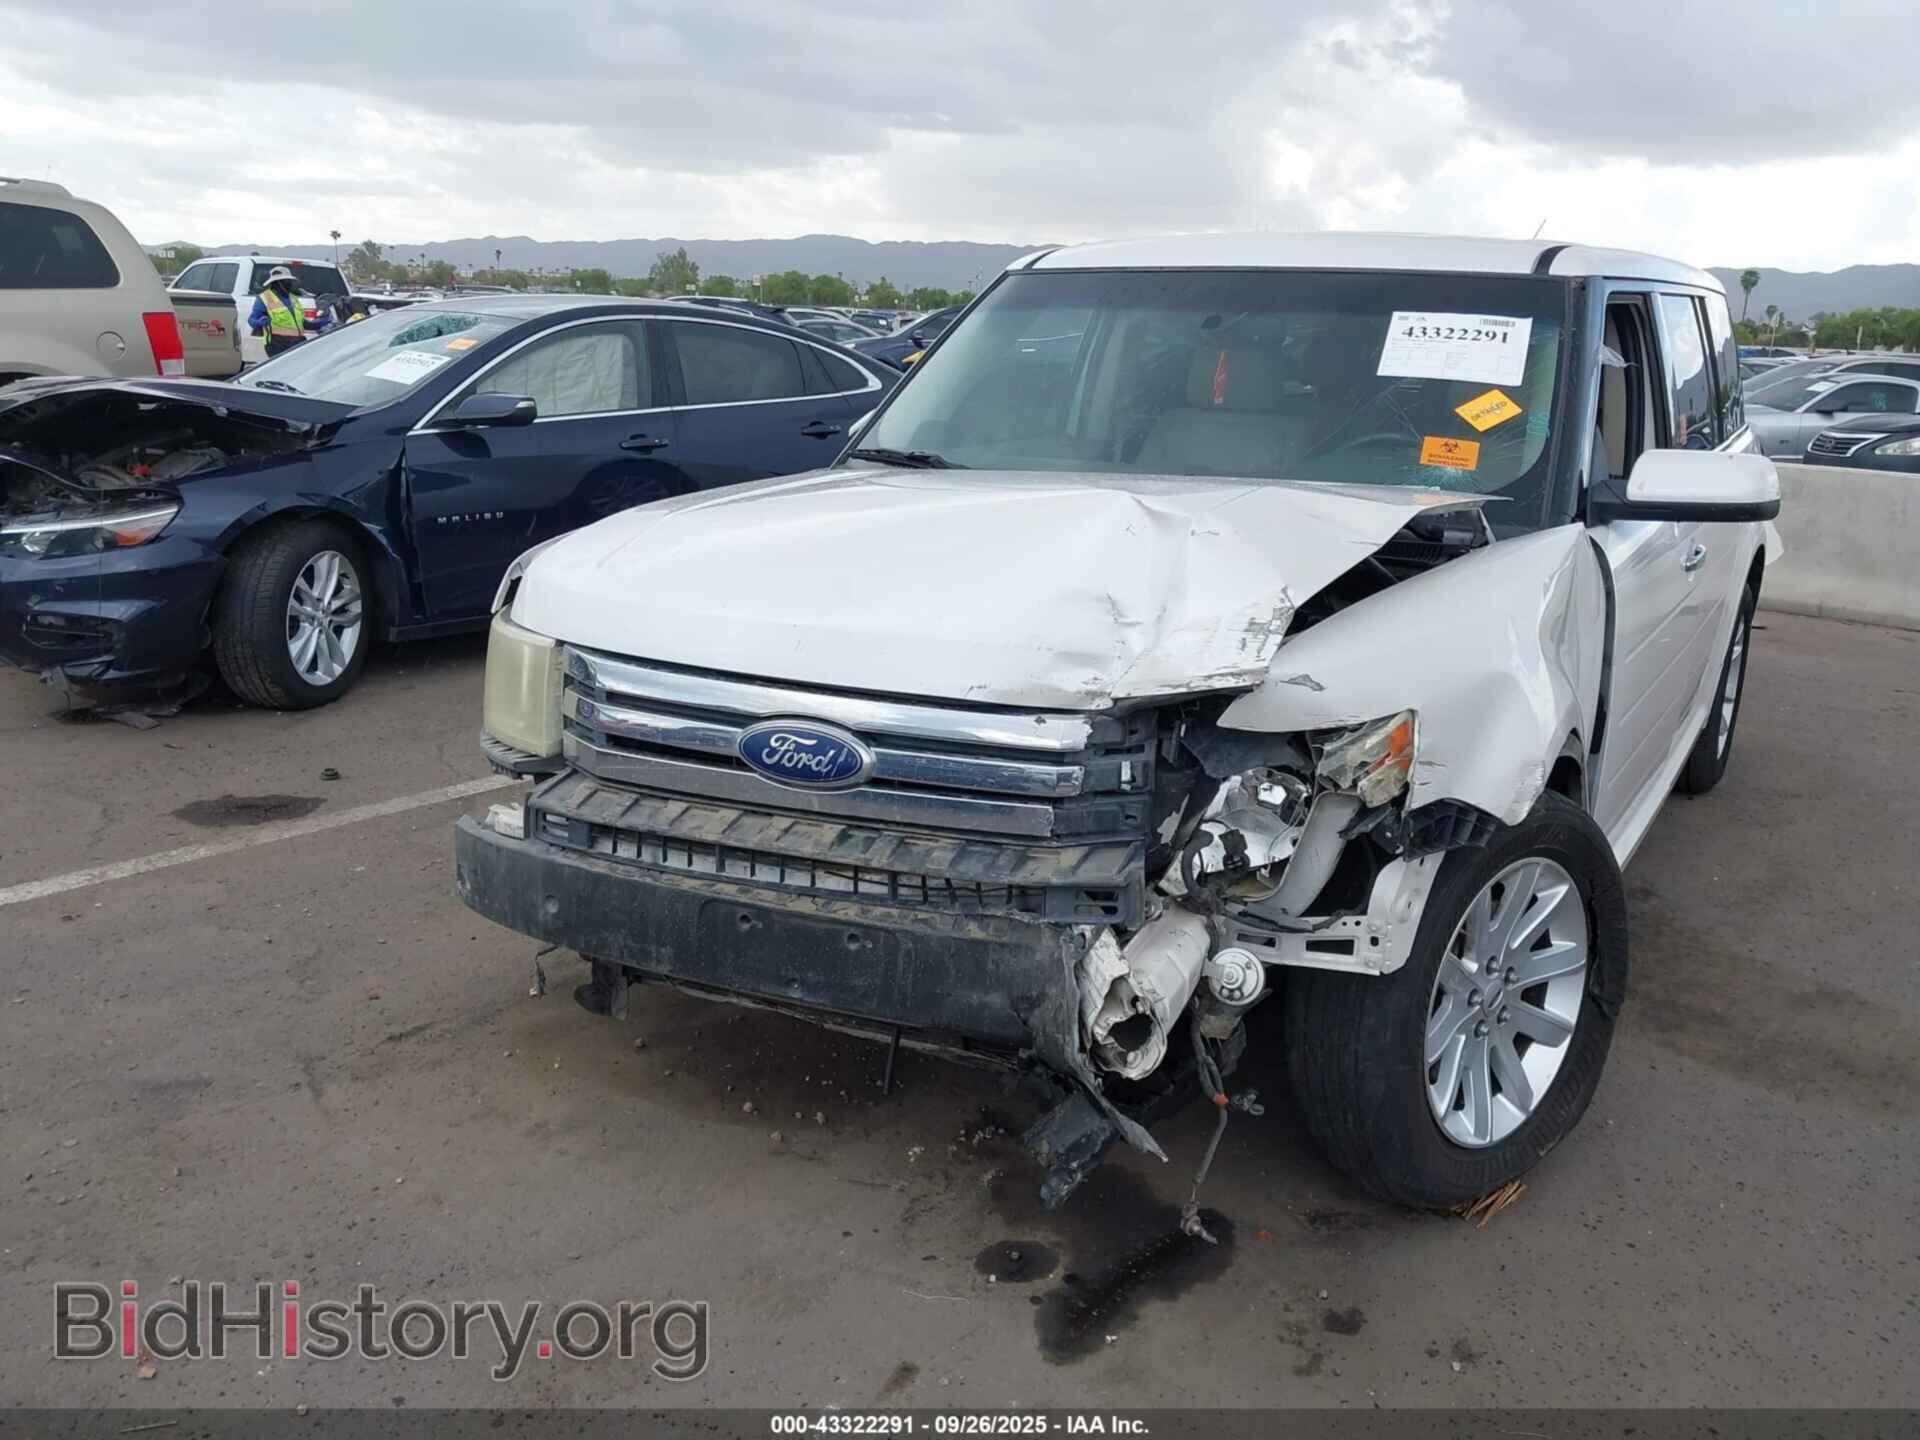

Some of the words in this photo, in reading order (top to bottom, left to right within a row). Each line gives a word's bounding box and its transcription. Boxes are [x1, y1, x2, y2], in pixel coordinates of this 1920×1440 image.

[1402, 326, 1509, 344] 43322291
[437, 511, 504, 523] MALIBU
[761, 733, 835, 773] Ford
